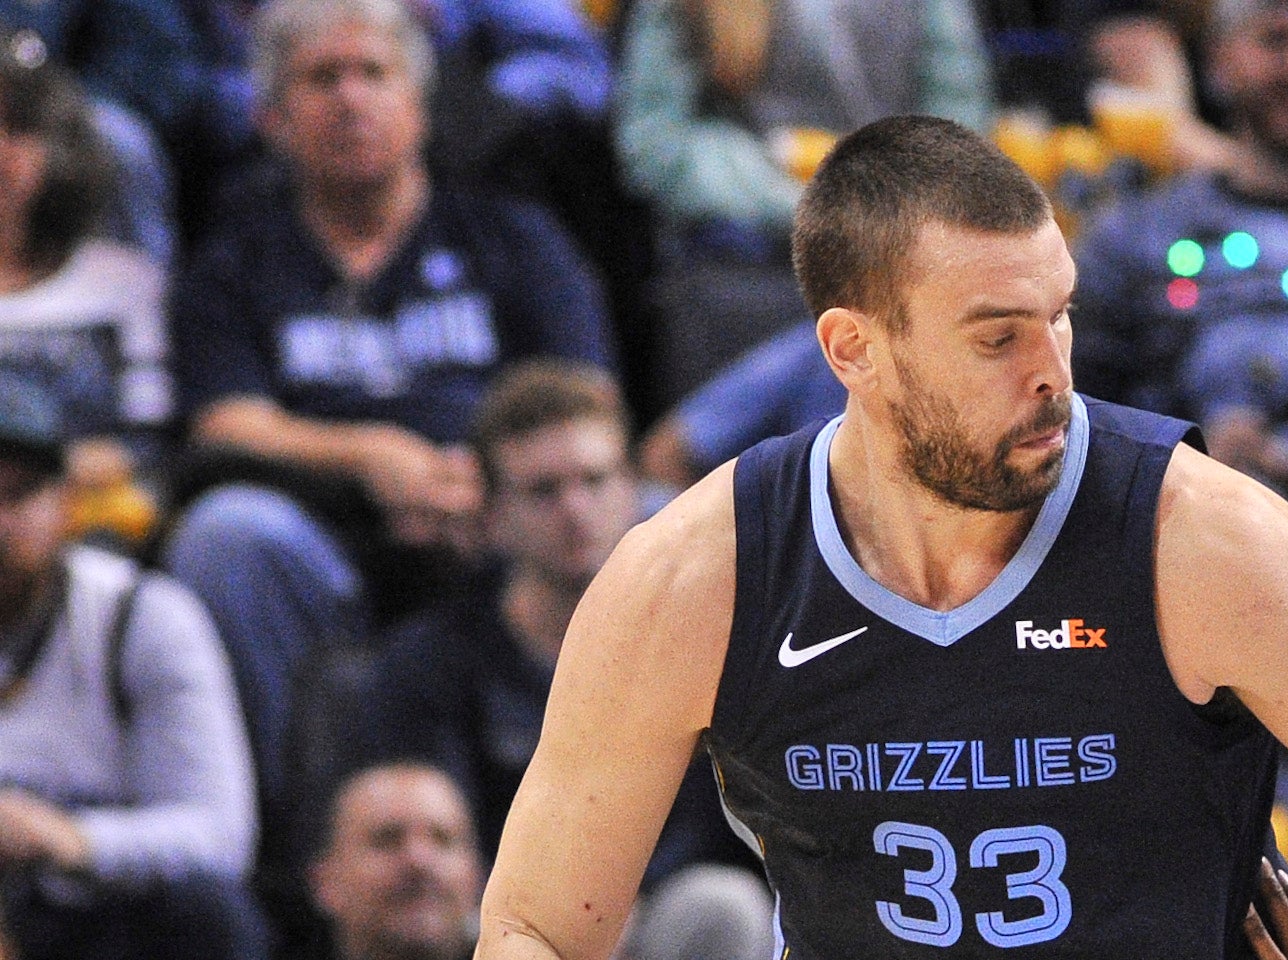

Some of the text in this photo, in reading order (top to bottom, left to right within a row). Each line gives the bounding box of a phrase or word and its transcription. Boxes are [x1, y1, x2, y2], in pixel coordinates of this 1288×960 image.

[1015, 618, 1107, 649] FedEx
[785, 734, 1117, 792] GRIZZLIES
[873, 820, 1073, 948] 33
